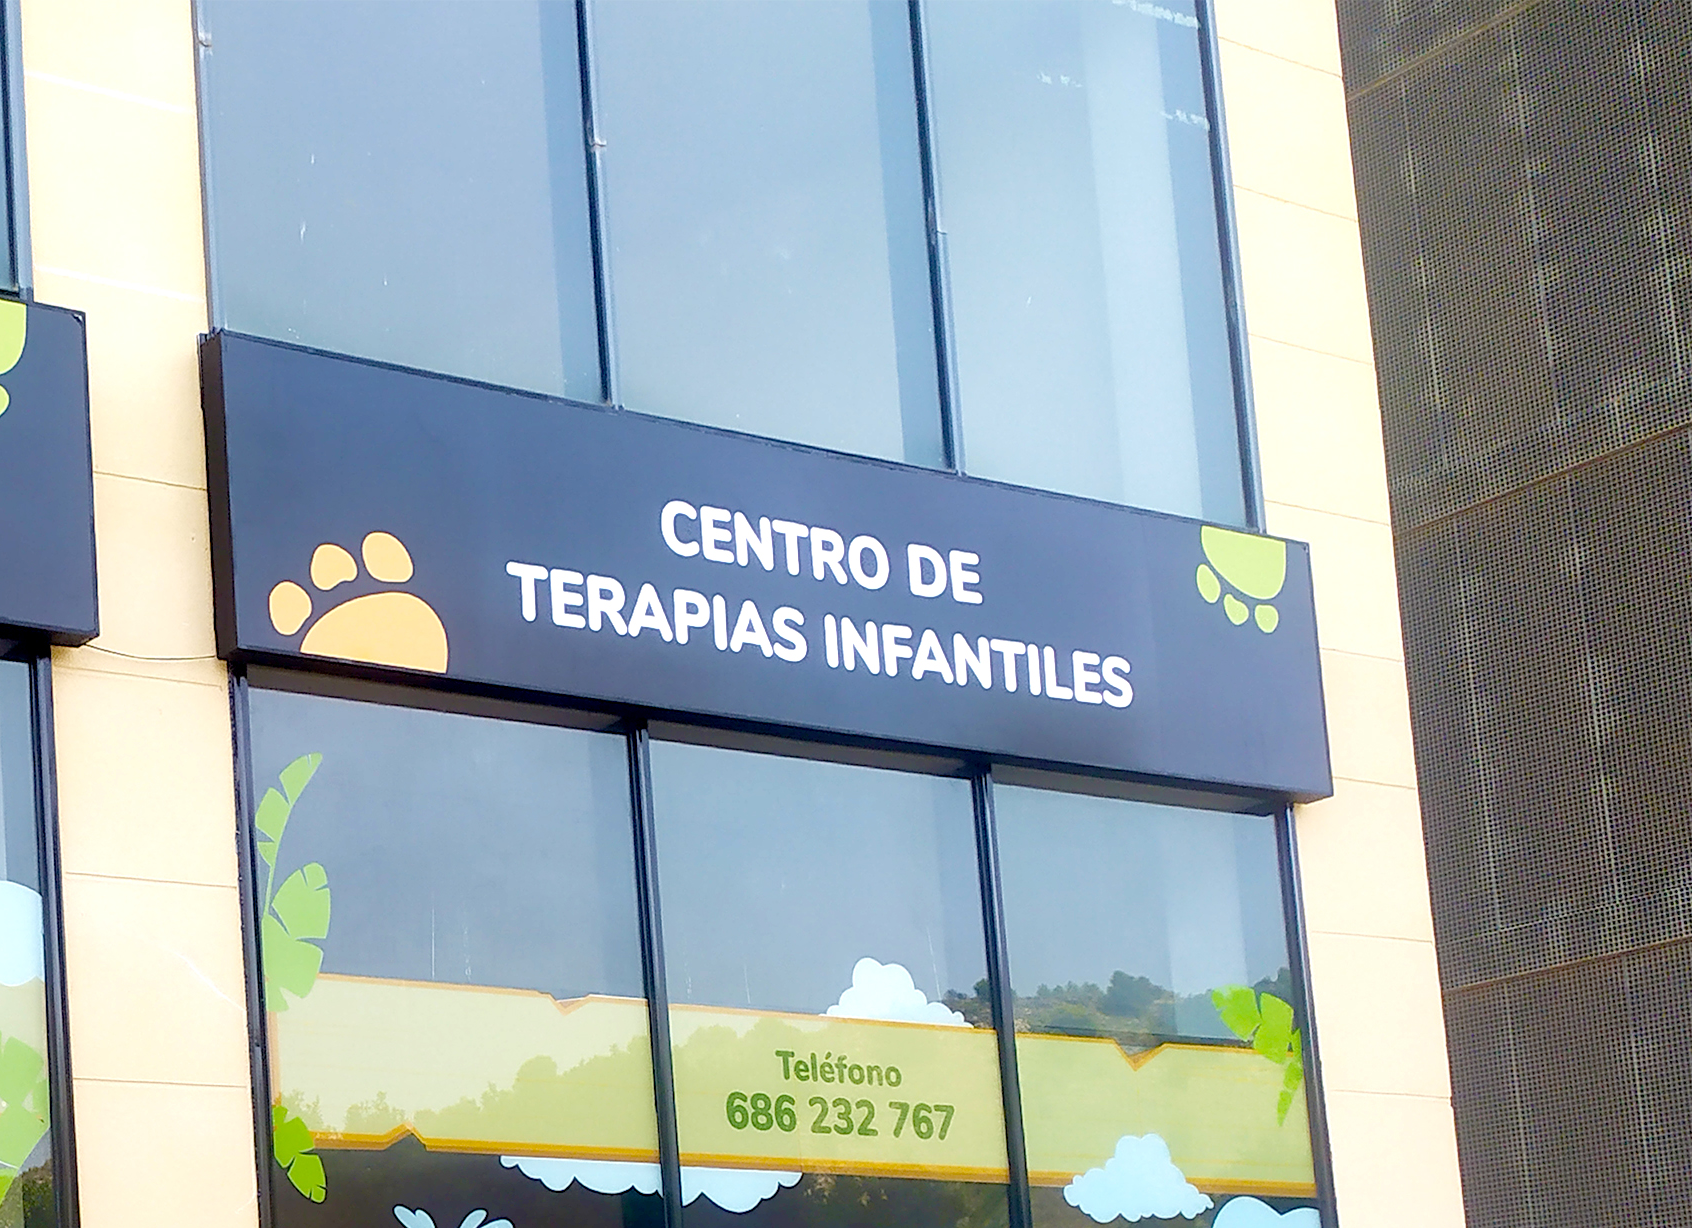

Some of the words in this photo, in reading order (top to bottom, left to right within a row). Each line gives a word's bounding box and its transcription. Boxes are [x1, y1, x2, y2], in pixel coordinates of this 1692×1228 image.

[660, 500, 890, 590] CENTRO
[906, 543, 984, 605] DE
[506, 561, 808, 663] TERAPIAS
[824, 613, 1134, 708] INFANTILES
[775, 1050, 902, 1087] Teléfono
[726, 1092, 797, 1132] 686
[808, 1097, 879, 1136] 232
[889, 1101, 955, 1140] 767
